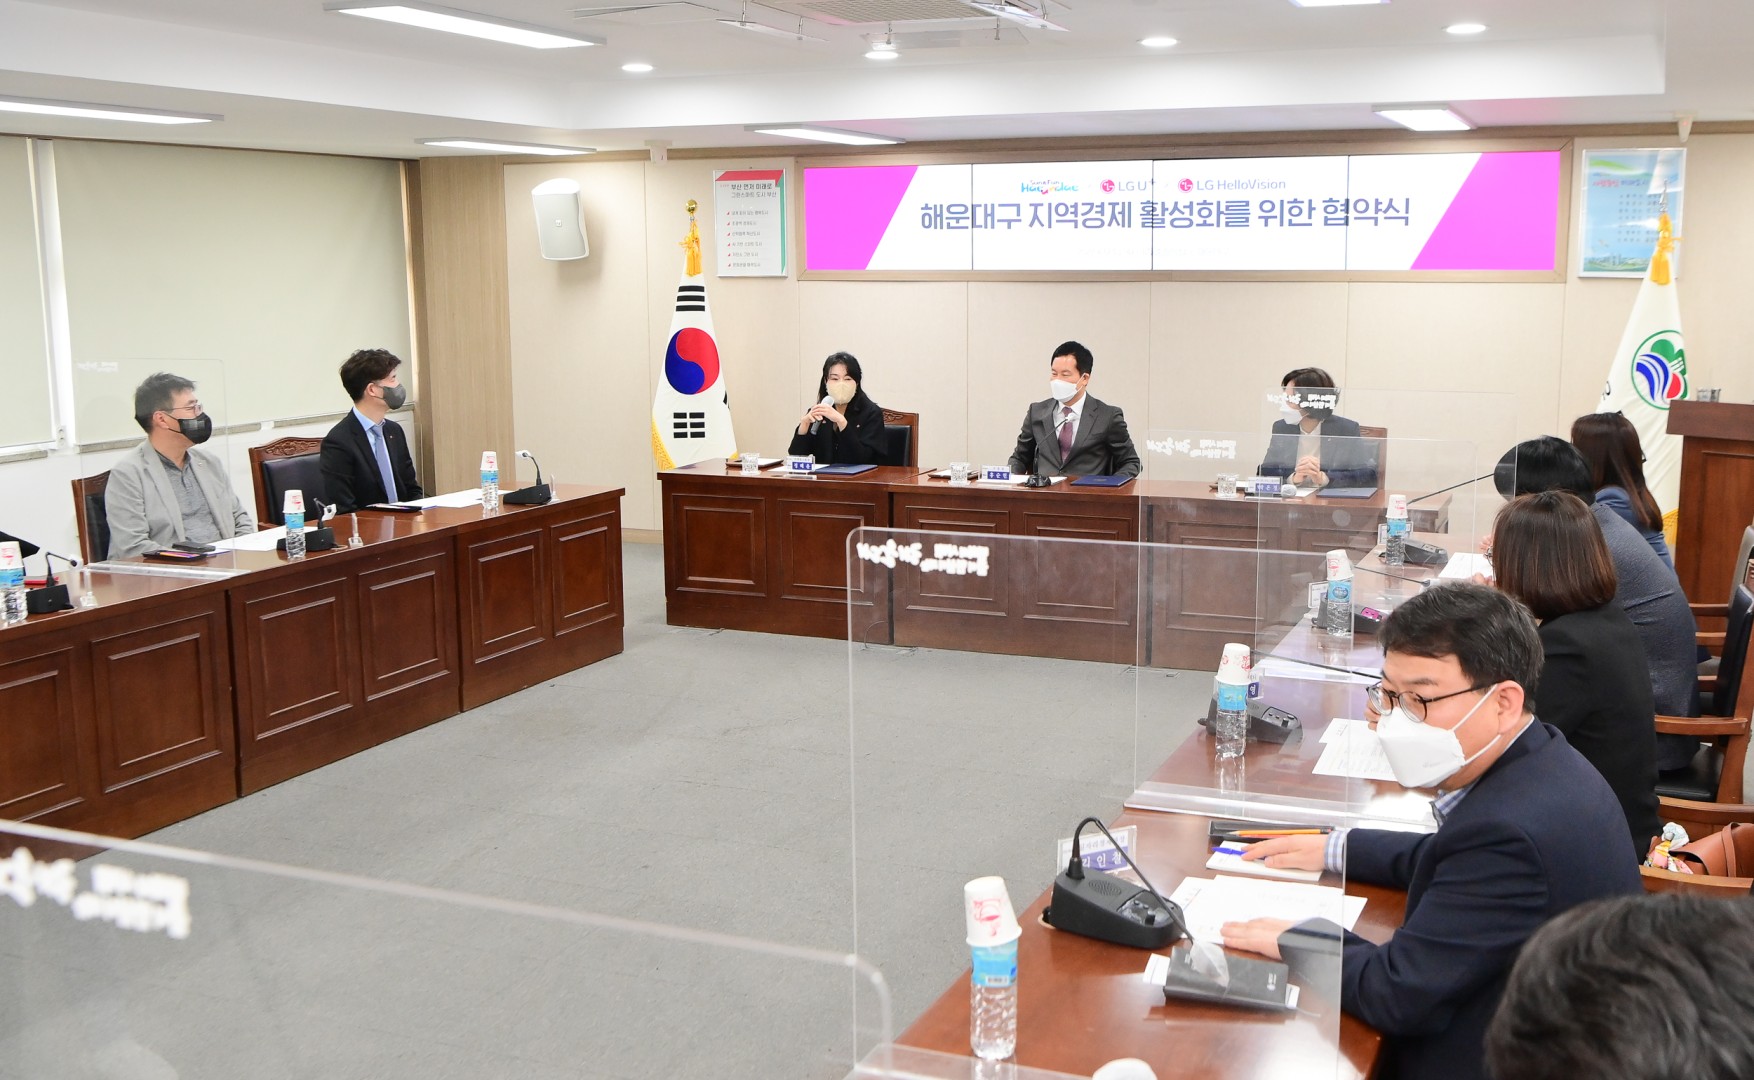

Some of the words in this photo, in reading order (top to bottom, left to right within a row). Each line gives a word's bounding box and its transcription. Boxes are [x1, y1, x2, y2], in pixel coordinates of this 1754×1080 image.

[1118, 181, 1135, 191] LG
[1196, 180, 1214, 191] LG
[1217, 179, 1286, 190] HelloVision
[920, 202, 1022, 229] 해운대구
[1028, 201, 1132, 229] 지역경제
[1139, 199, 1251, 229] 활성화를
[1258, 198, 1316, 228] 위한
[1322, 197, 1411, 227] 협약식
